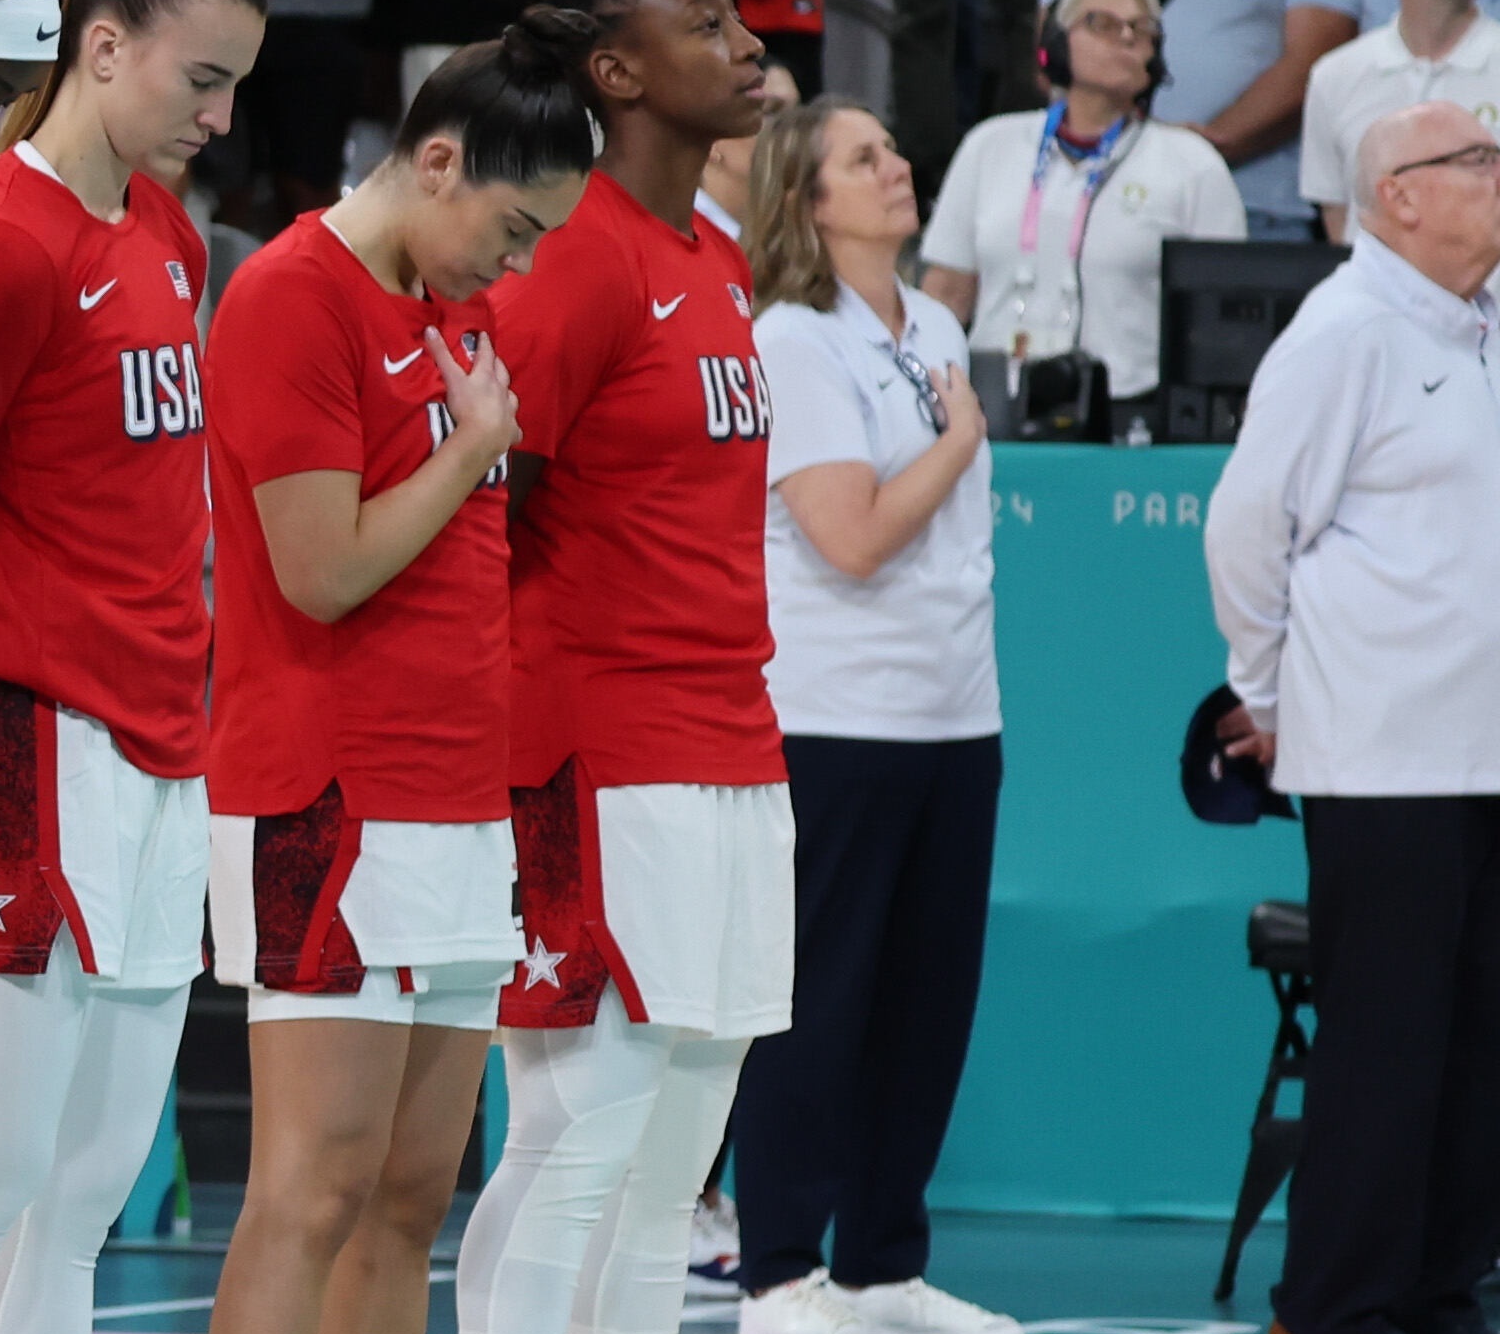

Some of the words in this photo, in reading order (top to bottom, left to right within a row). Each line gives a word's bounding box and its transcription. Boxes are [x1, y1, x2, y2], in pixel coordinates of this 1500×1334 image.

[120, 344, 202, 443] USA
[698, 356, 772, 442] USA
[1113, 489, 1200, 526] PAR
